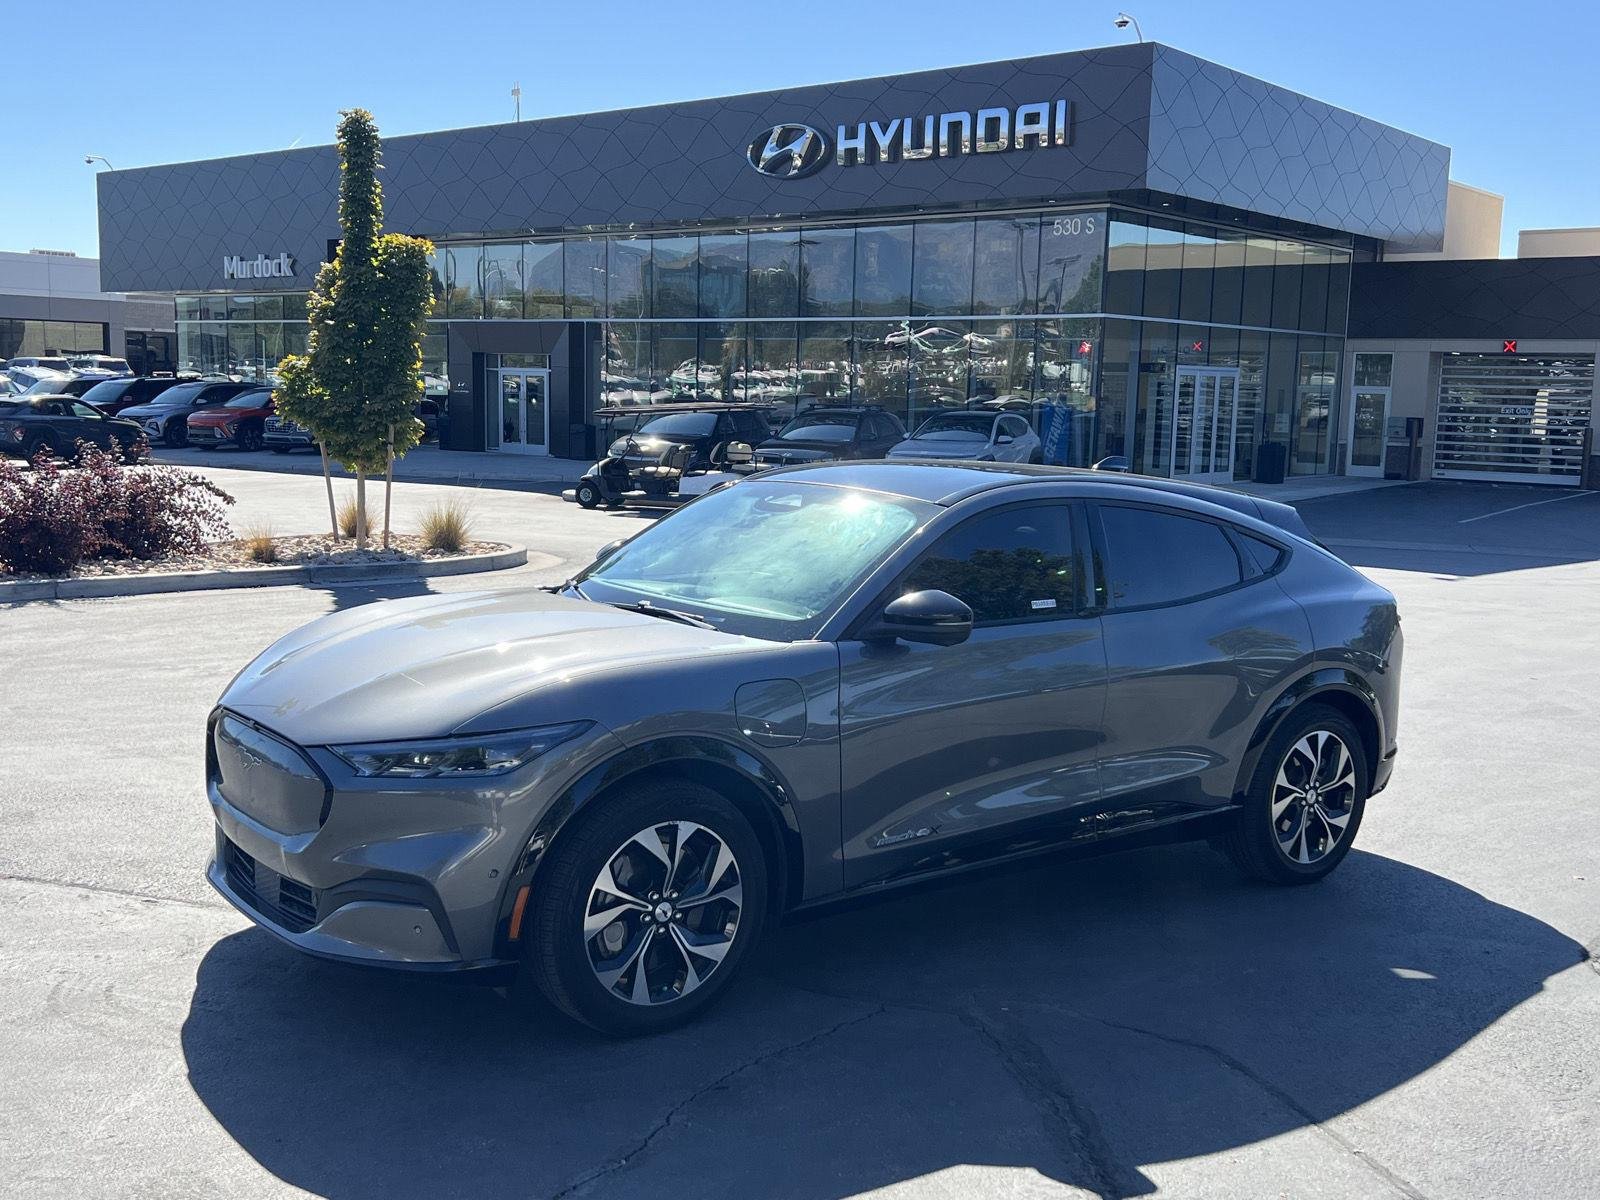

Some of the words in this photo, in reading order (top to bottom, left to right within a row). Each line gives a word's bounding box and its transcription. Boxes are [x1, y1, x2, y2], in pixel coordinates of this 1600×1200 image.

[836, 99, 1067, 167] HYUNDAI
[1053, 218, 1081, 235] 530
[1085, 217, 1095, 234] S
[223, 252, 294, 279] Murdock
